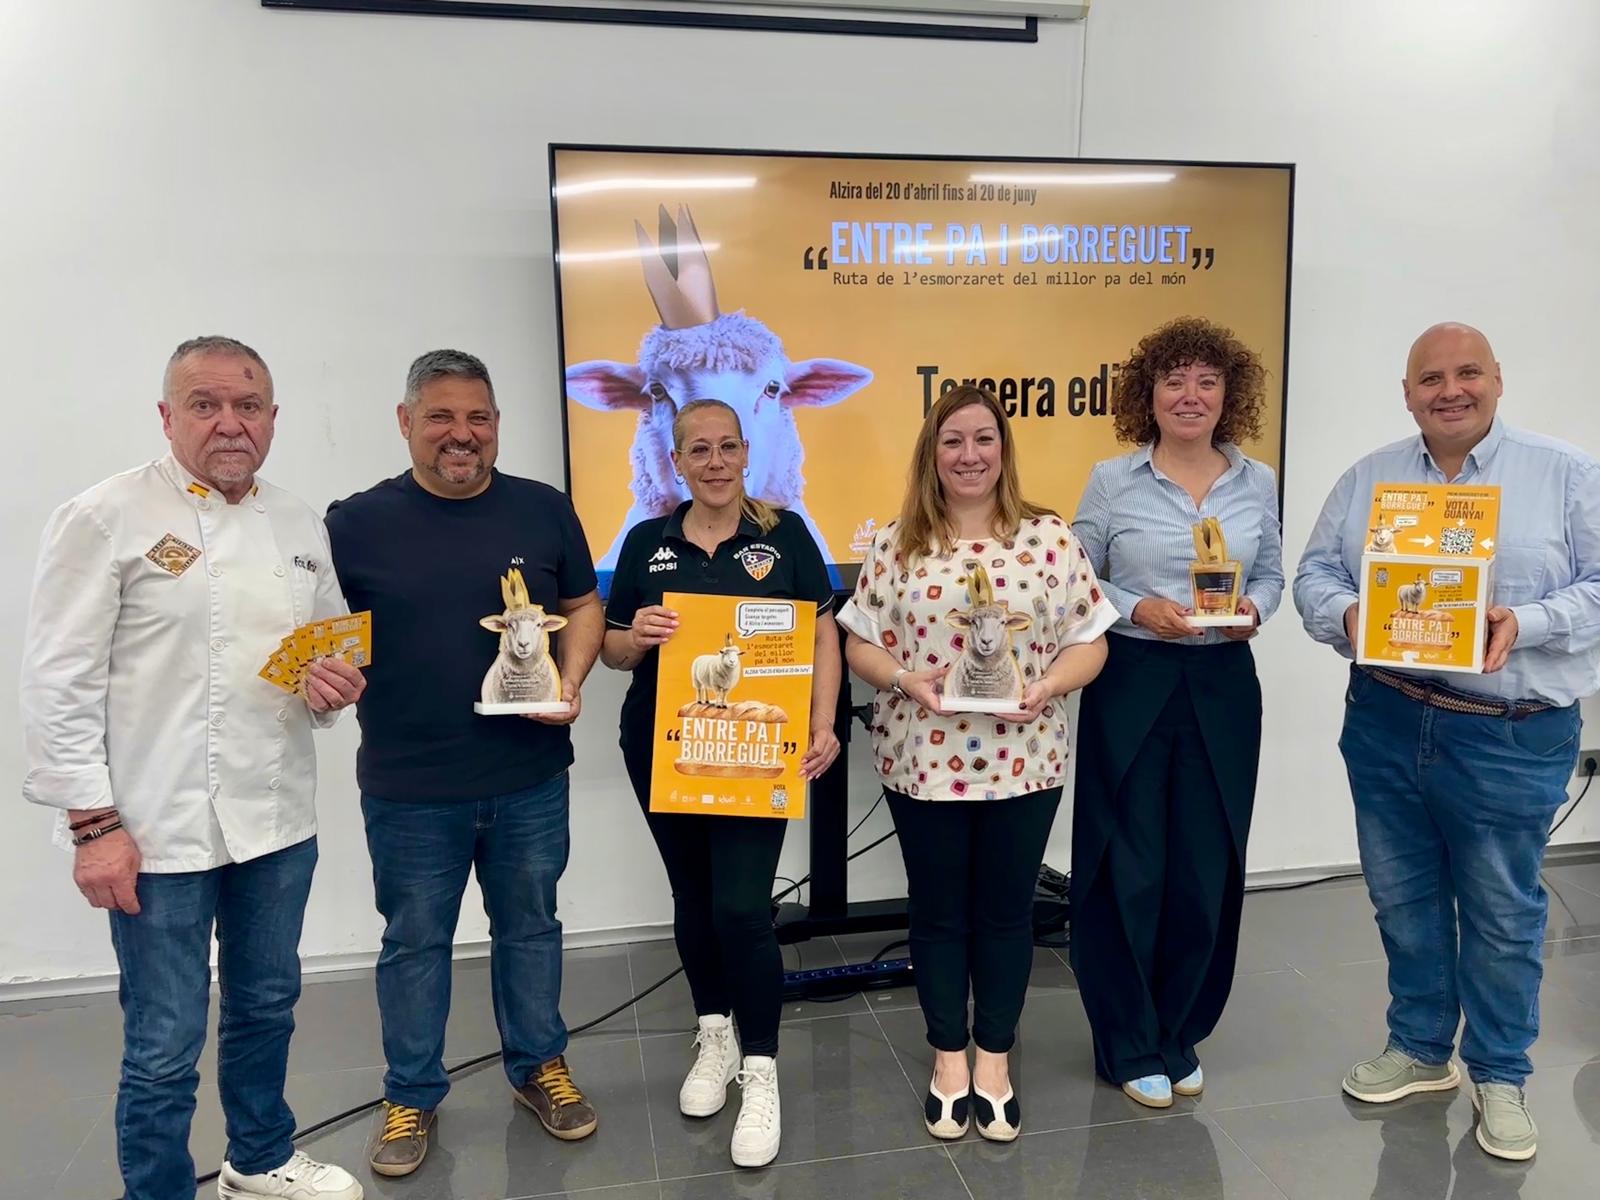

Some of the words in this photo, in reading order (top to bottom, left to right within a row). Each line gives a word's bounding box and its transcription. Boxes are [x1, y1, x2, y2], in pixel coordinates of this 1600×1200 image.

[830, 181, 862, 199] Alzira
[866, 183, 882, 199] del
[886, 183, 900, 199] 20
[904, 183, 939, 200] d'abril
[943, 184, 964, 201] fins
[967, 185, 977, 201] al
[980, 185, 994, 201] 20
[998, 185, 1011, 202] de
[1013, 185, 1037, 206] juny
[946, 223, 987, 265] PA
[1000, 223, 1008, 265] I
[833, 272, 868, 285] Ruta
[877, 272, 894, 285] de
[903, 272, 1004, 285] l'esmorzaret
[1013, 272, 1037, 285] del
[1047, 272, 1096, 285] millor
[1105, 275, 1120, 288] pa
[1129, 272, 1153, 285] del
[1162, 273, 1186, 285] món
[1446, 501, 1468, 510] VOTA
[1443, 510, 1484, 520] GUANYA!
[750, 544, 781, 559] ESTADIO
[649, 562, 677, 573] ROSI
[1429, 620, 1443, 632] PA
[746, 720, 768, 742] PA
[776, 722, 781, 743] I
